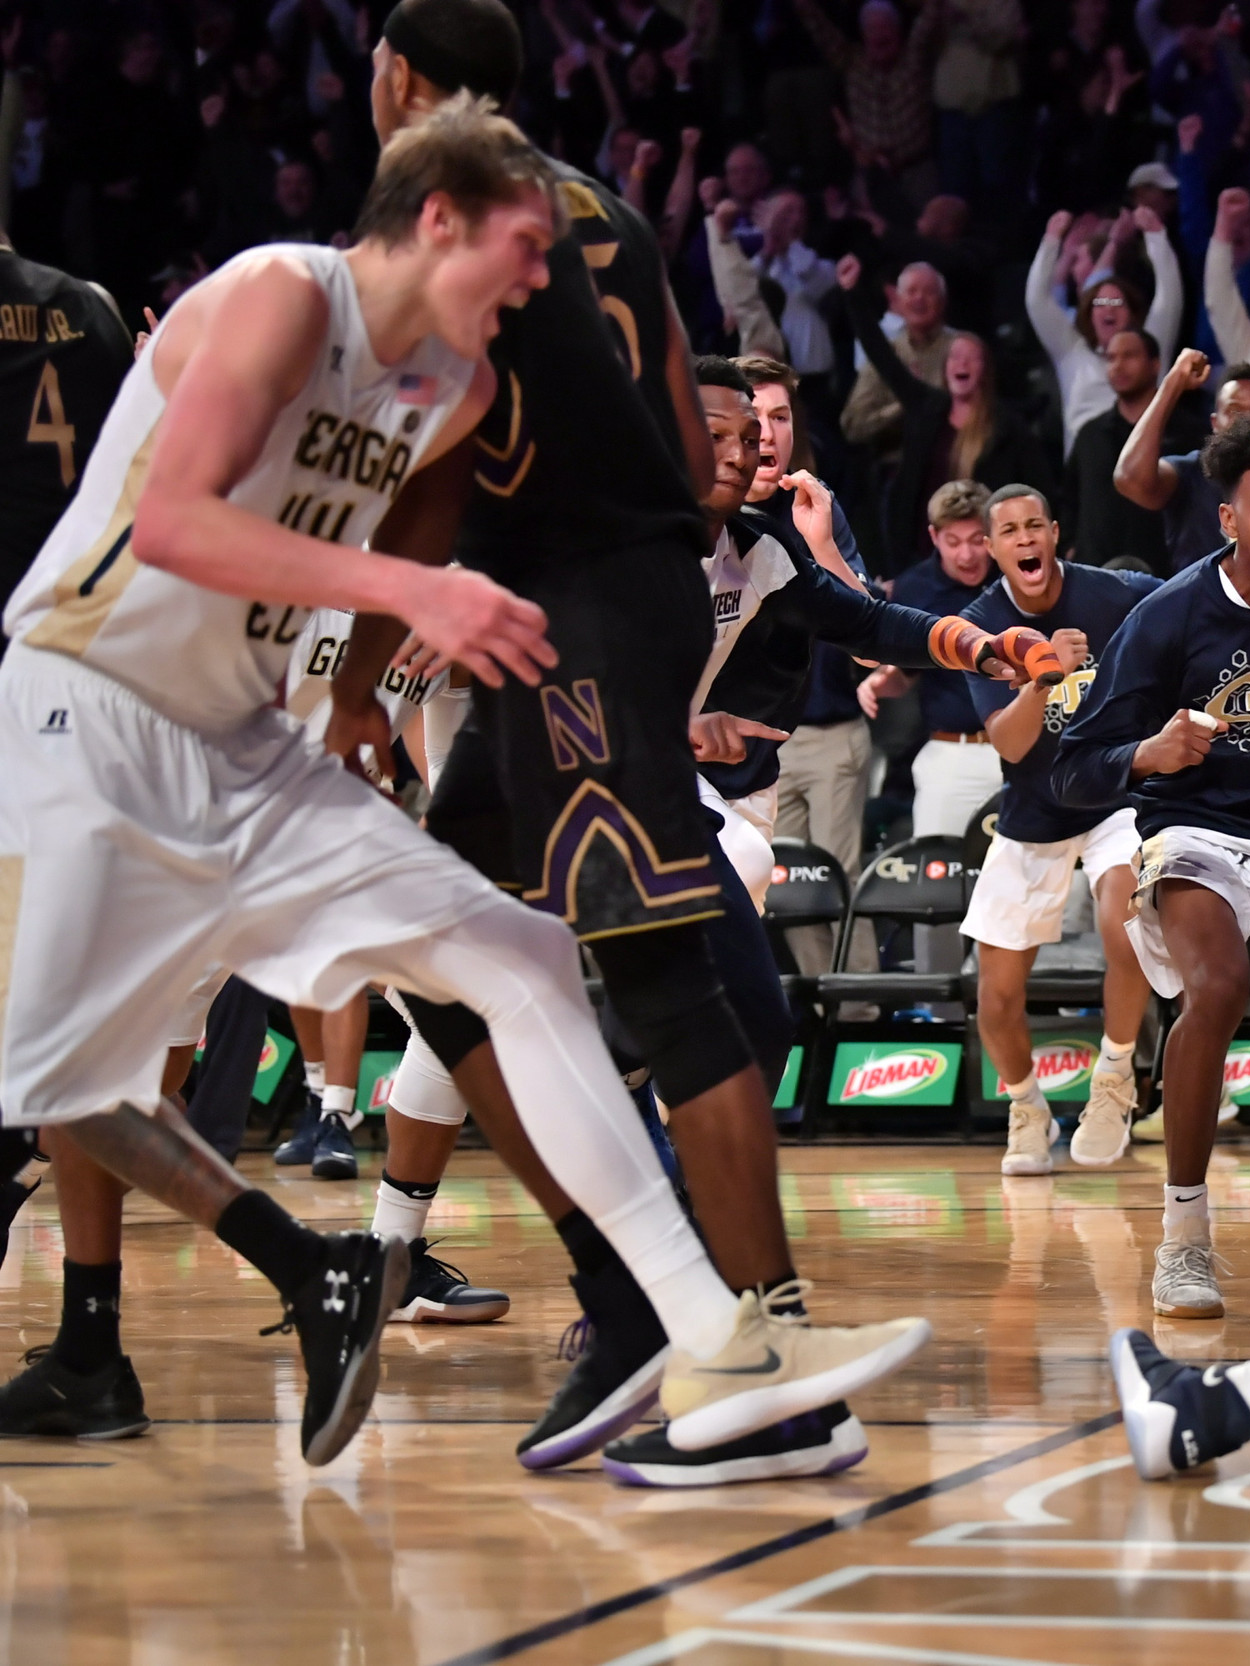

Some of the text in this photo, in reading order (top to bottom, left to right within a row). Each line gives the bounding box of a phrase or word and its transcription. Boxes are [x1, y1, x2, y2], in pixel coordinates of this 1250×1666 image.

[0, 304, 86, 343] AW JR.
[27, 359, 77, 488] 4
[540, 678, 611, 771] N
[788, 865, 831, 882] PNC
[840, 1057, 939, 1102] LIBMAN
